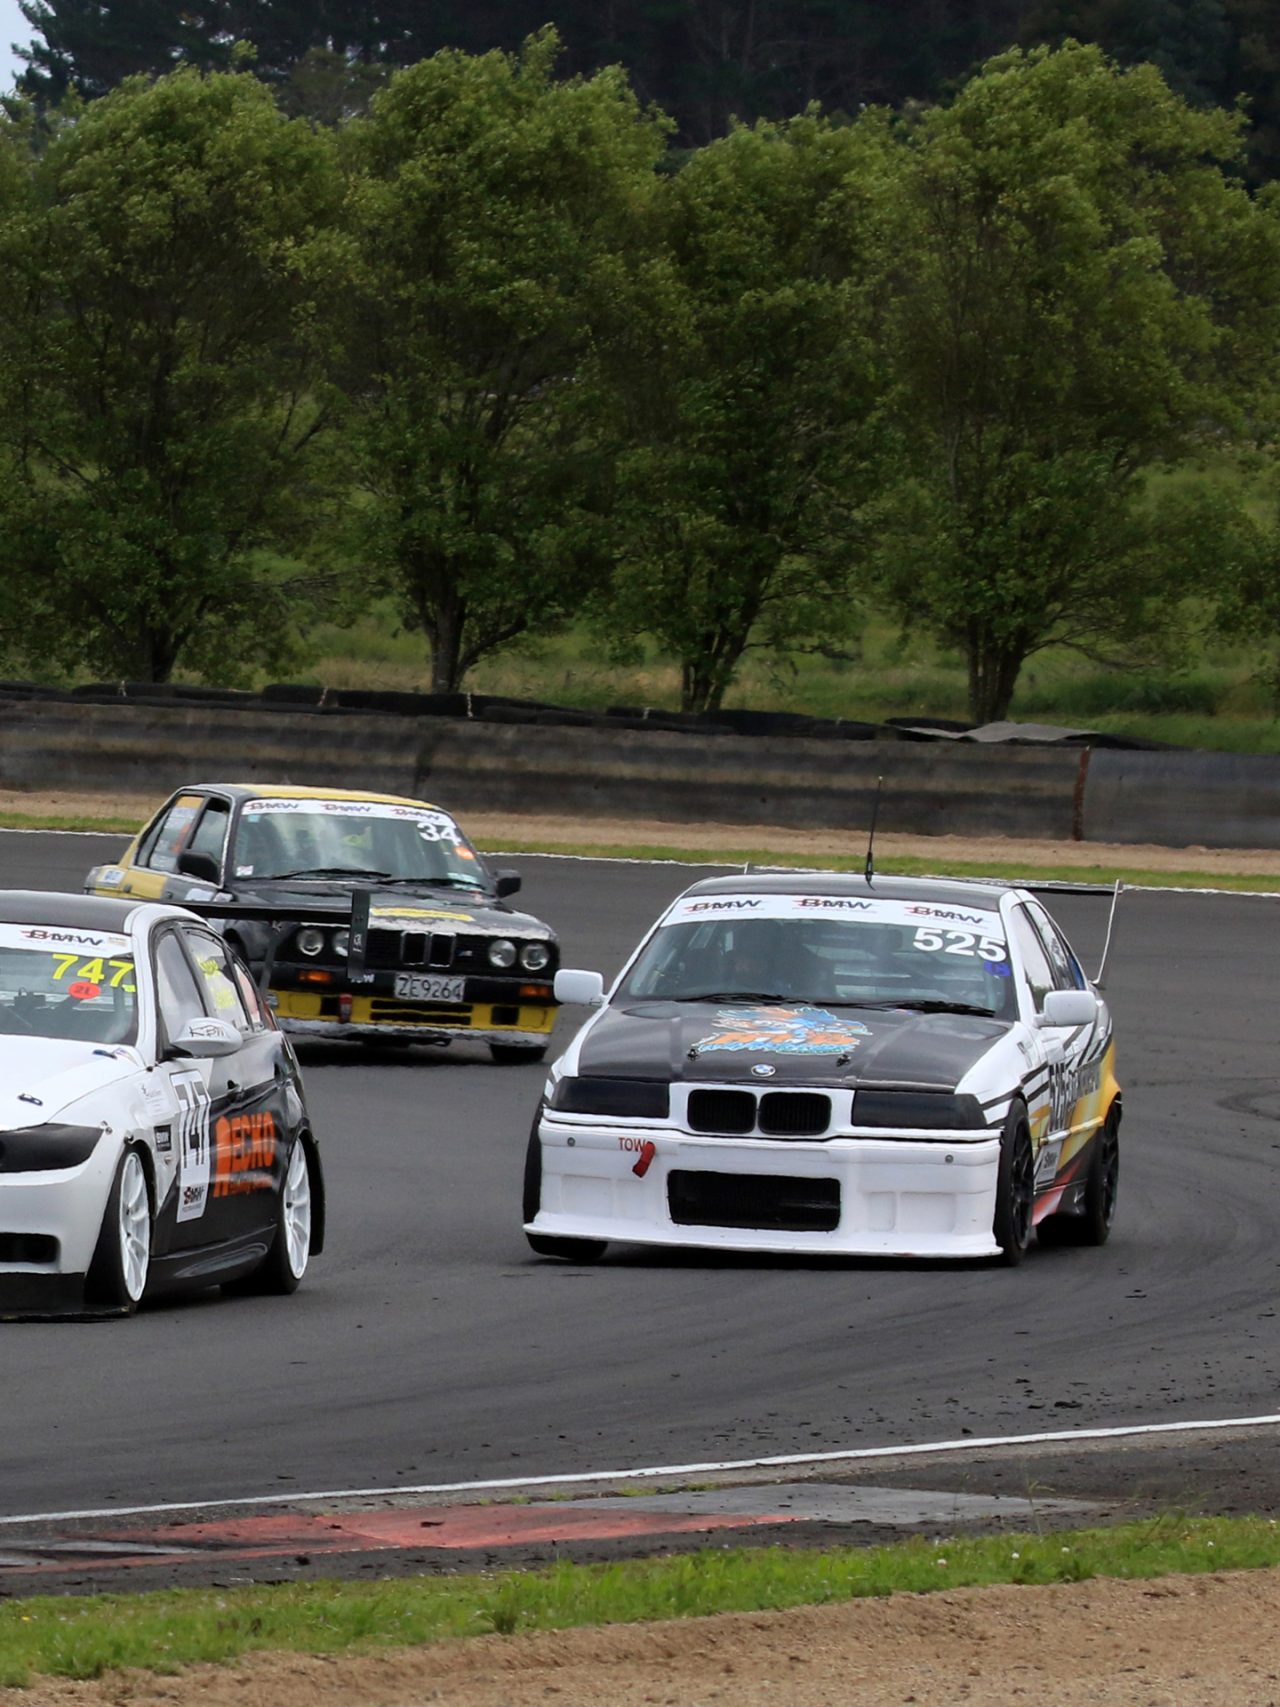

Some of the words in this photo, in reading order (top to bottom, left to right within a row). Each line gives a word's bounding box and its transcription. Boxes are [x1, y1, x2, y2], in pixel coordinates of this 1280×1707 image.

[417, 823, 462, 846] 34
[689, 900, 762, 912] BMW
[798, 898, 872, 909] BMW
[909, 906, 983, 923] BMW
[26, 929, 103, 946] BMW
[913, 927, 1007, 963] 525
[52, 953, 135, 987] 747
[399, 975, 463, 1000] ZE9264
[174, 1080, 209, 1168] 747
[618, 1136, 646, 1152] TOW
